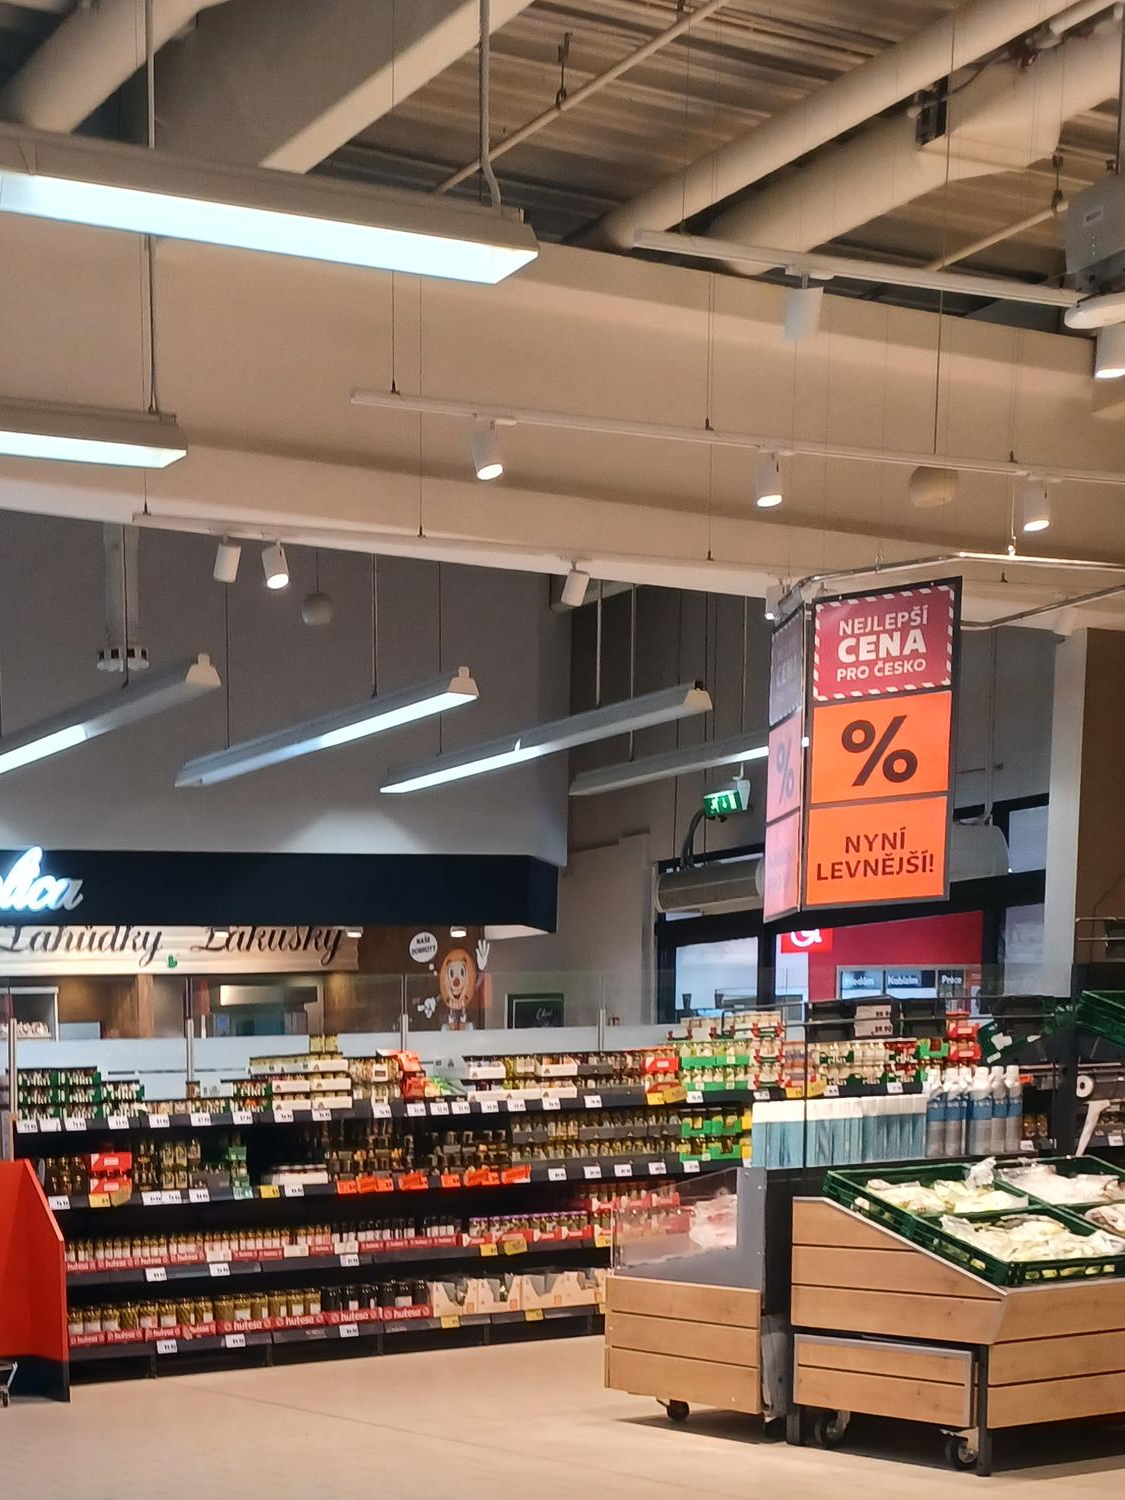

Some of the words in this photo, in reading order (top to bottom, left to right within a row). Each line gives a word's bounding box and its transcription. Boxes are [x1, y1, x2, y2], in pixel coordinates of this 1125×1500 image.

[838, 604, 929, 636] NEJLEPŠÍ
[837, 628, 927, 664] CENA
[836, 663, 870, 683] PRO
[873, 657, 927, 678] ČESKO
[840, 714, 919, 788] %
[844, 826, 908, 854] NYNÍ
[816, 849, 935, 882] LEVNĚJŠÍ!
